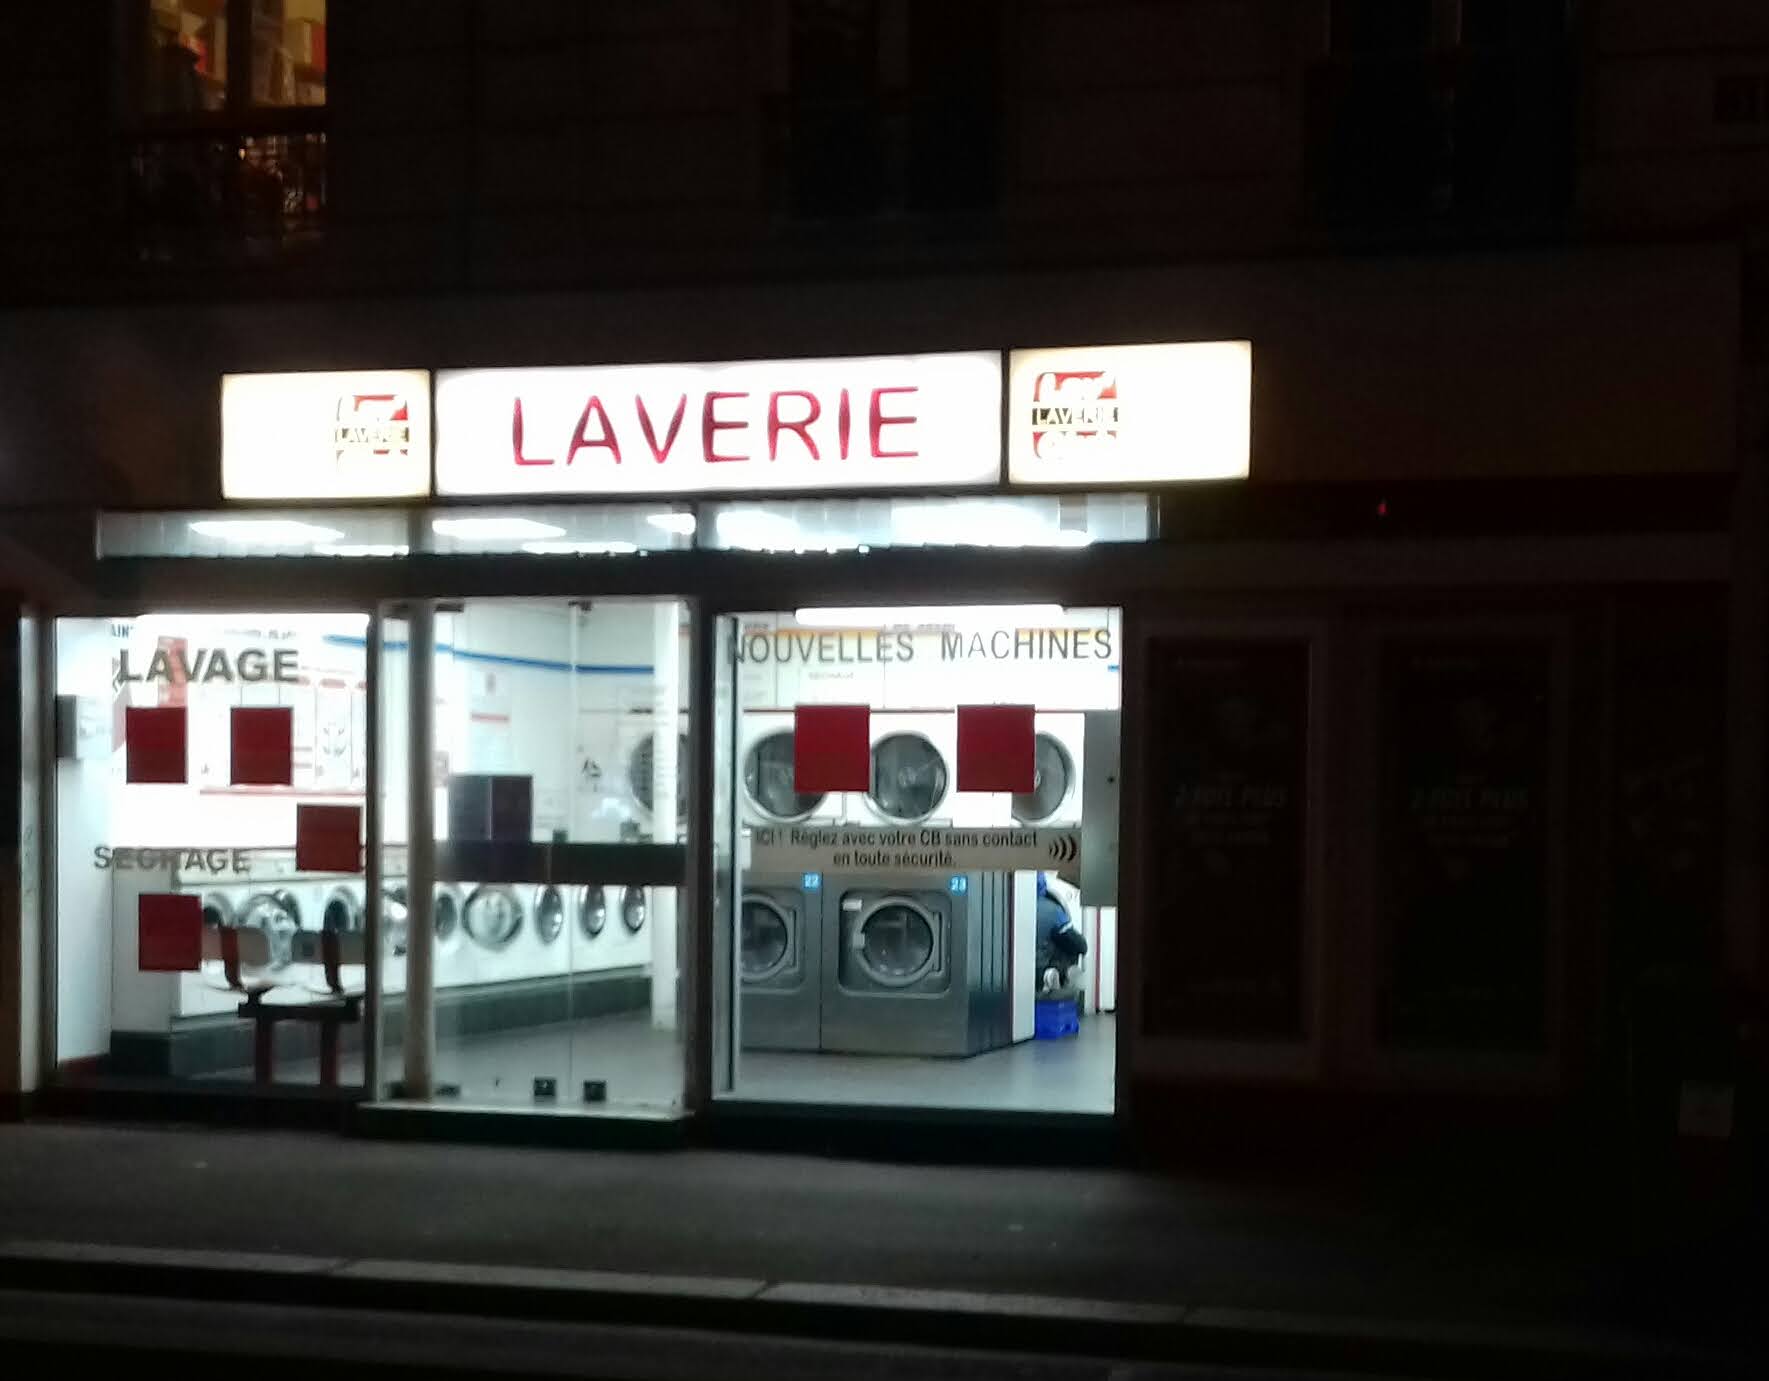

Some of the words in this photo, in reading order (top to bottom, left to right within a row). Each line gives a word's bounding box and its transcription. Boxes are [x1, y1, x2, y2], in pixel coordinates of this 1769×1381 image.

[511, 386, 920, 466] LAVERIE
[1036, 407, 1117, 425] LAVERIE
[728, 631, 914, 664] NOUVELLES
[941, 628, 1112, 662] MACHINES
[119, 648, 299, 683] LAVAGE
[842, 830, 876, 846] avec
[879, 830, 917, 846] votre
[920, 829, 941, 846] CB
[945, 829, 979, 847] sans
[982, 829, 1037, 847] contact
[833, 852, 850, 866] en
[854, 849, 891, 866] toute
